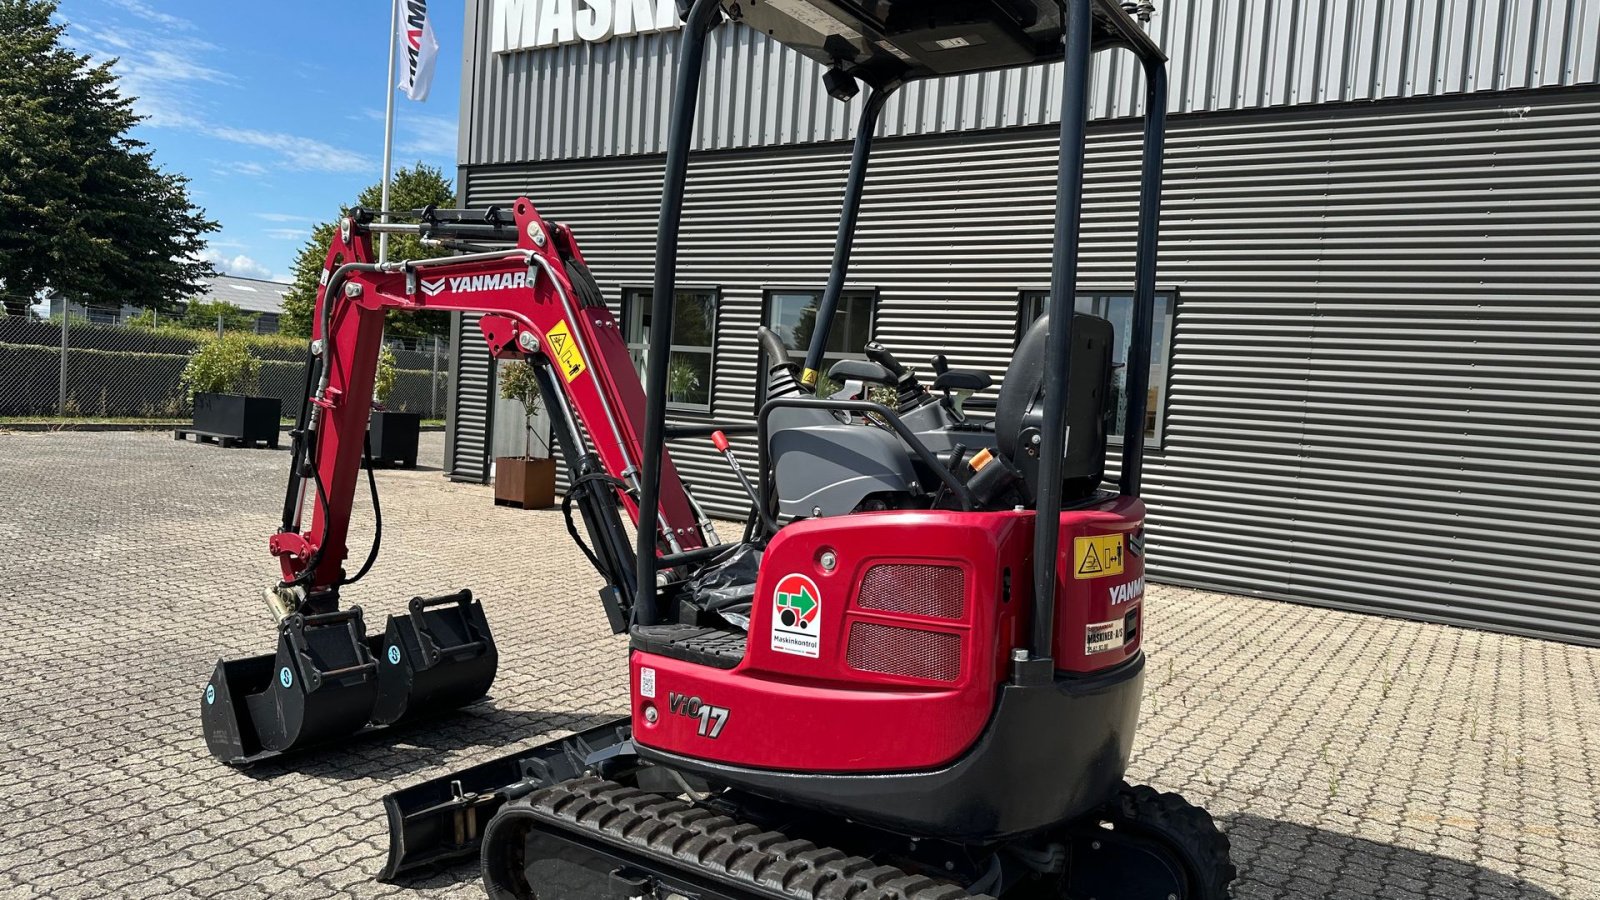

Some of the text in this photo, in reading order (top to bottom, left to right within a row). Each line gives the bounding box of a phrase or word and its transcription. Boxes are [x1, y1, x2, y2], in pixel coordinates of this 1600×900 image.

[449, 271, 526, 294] YANMAR
[1109, 576, 1145, 606] YANM
[774, 635, 818, 649] Maskinkontrol
